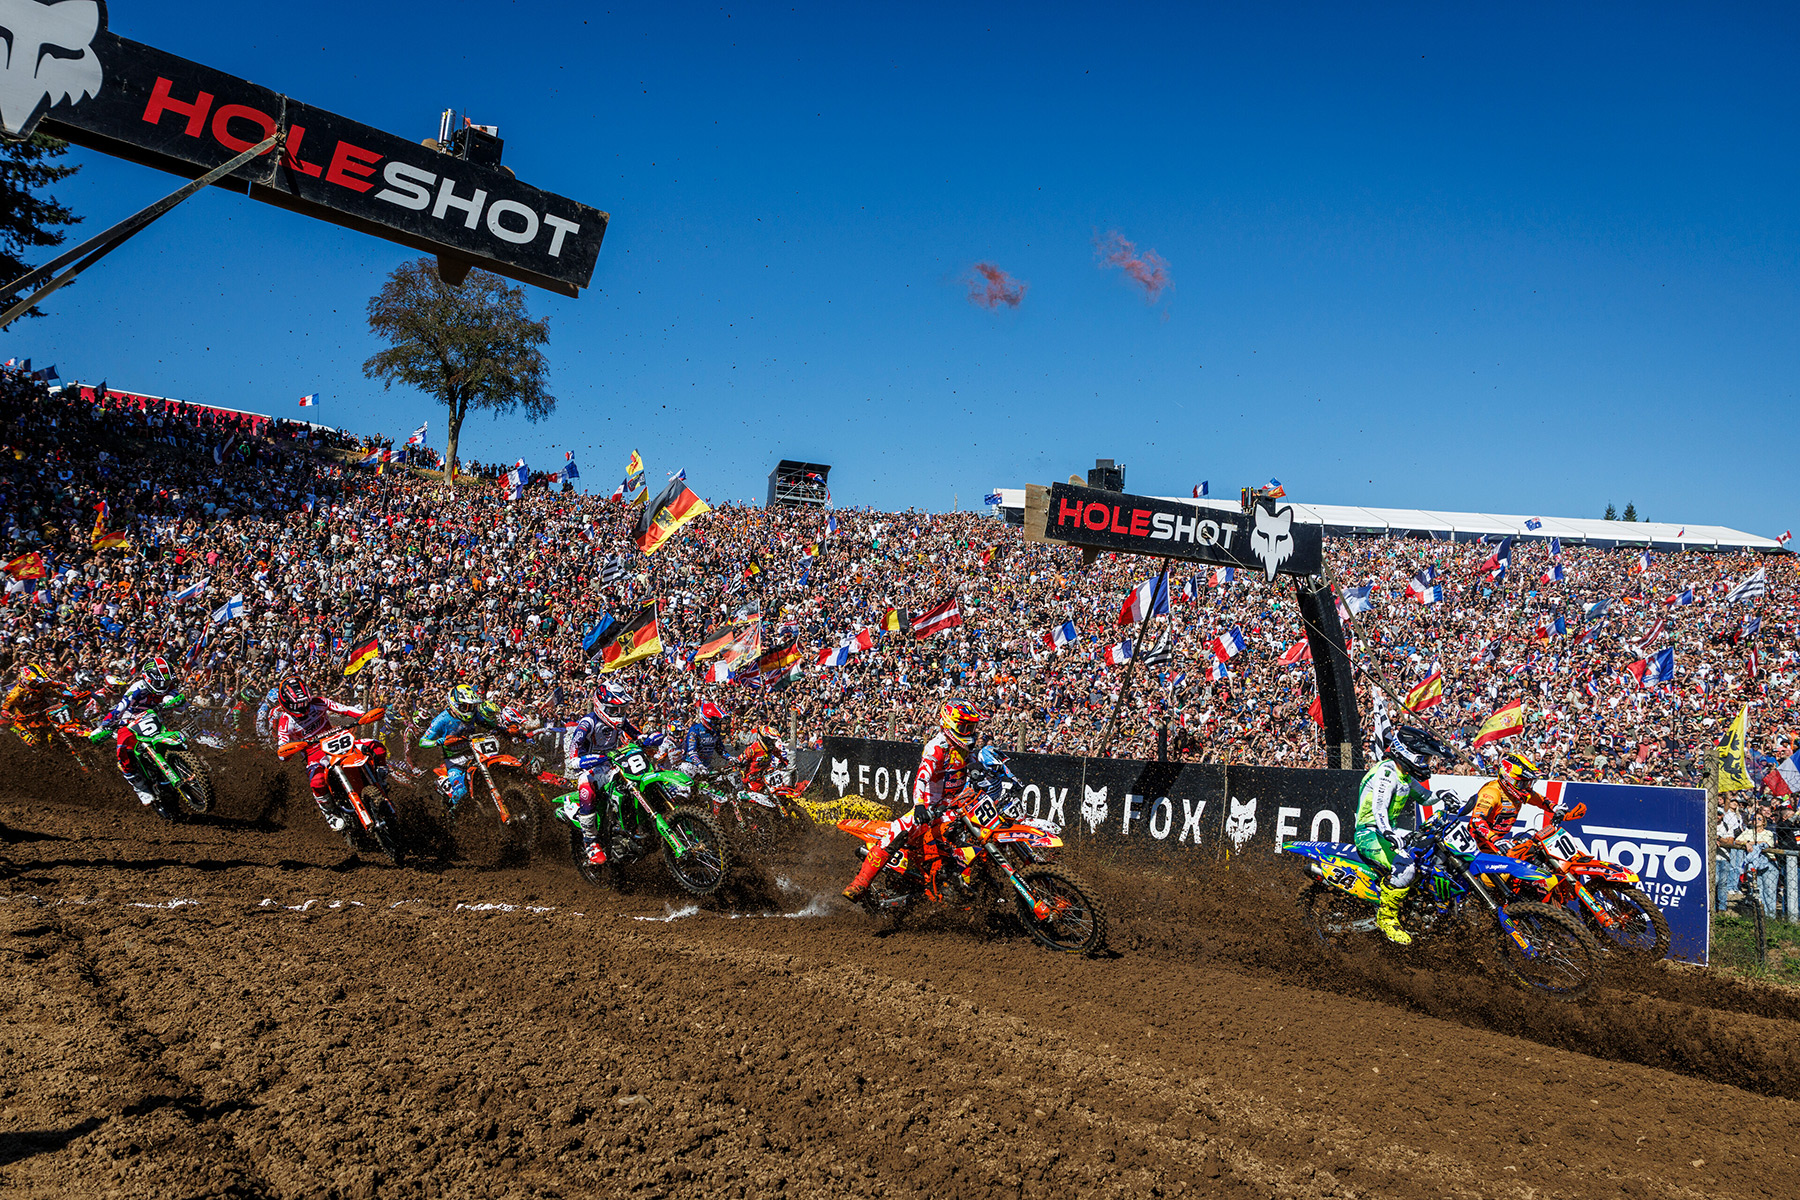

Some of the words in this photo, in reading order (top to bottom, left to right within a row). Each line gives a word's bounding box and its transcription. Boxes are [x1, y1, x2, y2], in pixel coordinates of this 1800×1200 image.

[142, 76, 581, 258] HOLESHOT
[1058, 498, 1238, 549] HOLESHOT
[138, 717, 158, 736] 5
[327, 735, 352, 754] 58
[627, 754, 647, 774] 8
[858, 765, 911, 804] FOX
[974, 799, 997, 827] 28
[1122, 794, 1206, 844] FOX
[1274, 806, 1342, 854] FO
[1453, 825, 1476, 852] 34
[885, 849, 904, 867] 8
[1554, 835, 1576, 859] 10
[1326, 867, 1358, 891] 34
